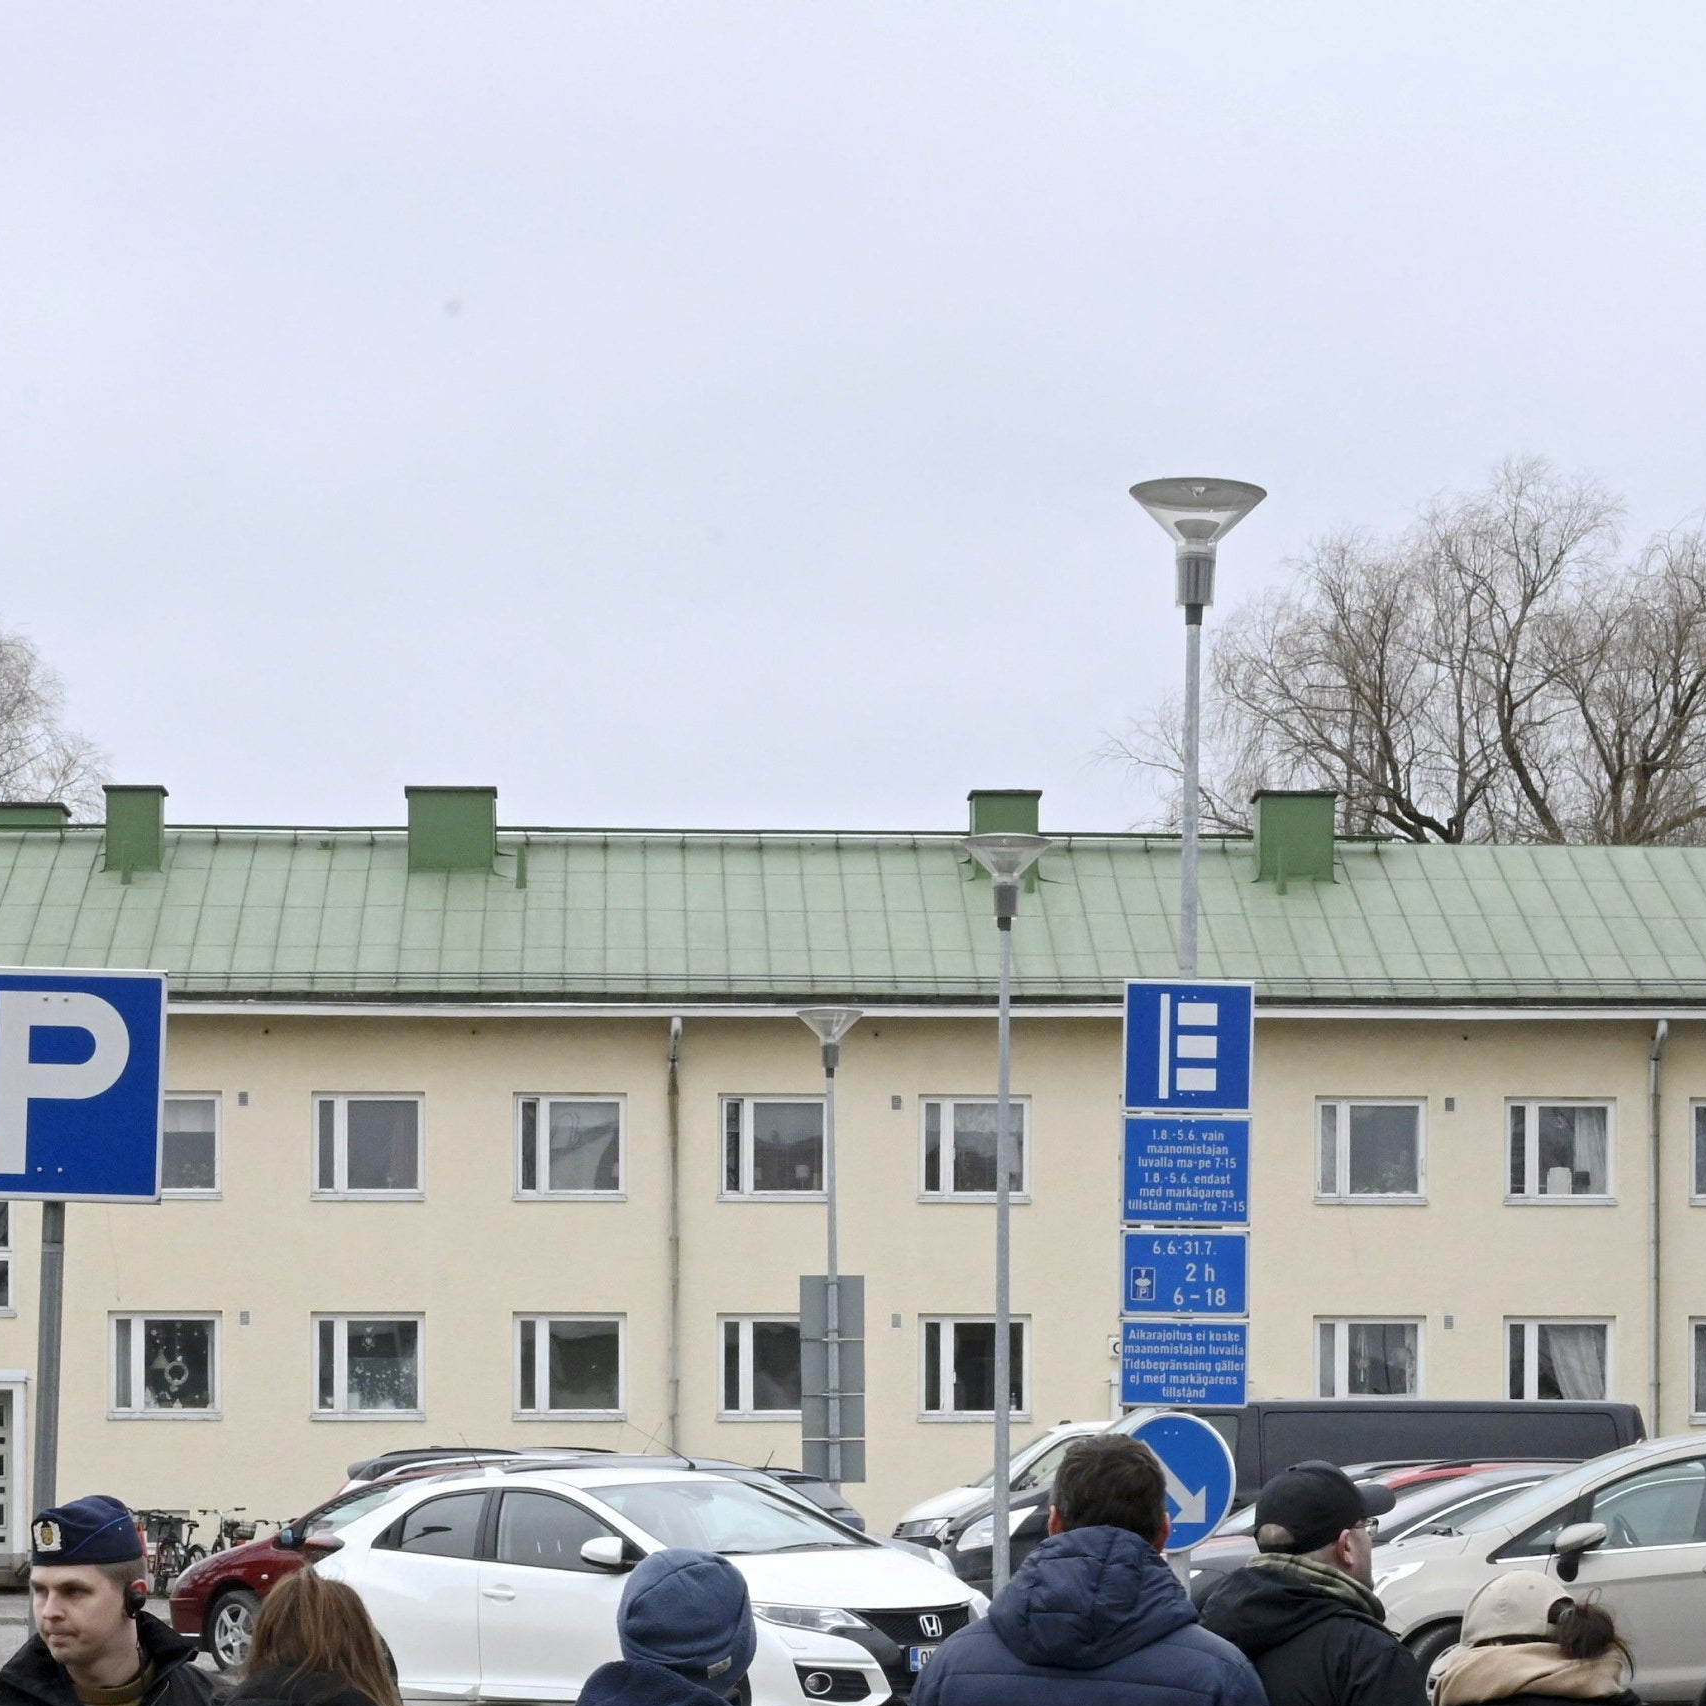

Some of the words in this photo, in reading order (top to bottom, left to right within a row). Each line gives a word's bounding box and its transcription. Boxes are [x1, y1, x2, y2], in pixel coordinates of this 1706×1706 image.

[1202, 1130, 1224, 1141] vain
[1147, 1144, 1229, 1156] maanomistajan
[1138, 1156, 1173, 1168] luvalla
[1177, 1160, 1211, 1170] ma-pe
[1215, 1157, 1237, 1169] 7-15
[1194, 1174, 1231, 1185] endast
[1139, 1186, 1162, 1197] med
[1166, 1187, 1234, 1199] markägarens
[1128, 1199, 1172, 1211] tillstånd
[1175, 1200, 1218, 1212] mån-fre
[1221, 1201, 1245, 1212] 7-15
[1185, 1263, 1197, 1282] 2
[1204, 1263, 1215, 1282] h
[1129, 1329, 1193, 1342] Aikarajoitus
[1196, 1331, 1206, 1341] ei
[1209, 1331, 1240, 1342] koske
[1124, 1343, 1206, 1356] maanomistajan
[1209, 1344, 1245, 1356] luvalla
[1124, 1358, 1212, 1372] Tidsbegränsning
[1215, 1360, 1245, 1372] gäller
[1130, 1374, 1140, 1385] ej
[1143, 1373, 1166, 1384] med
[1169, 1373, 1238, 1386] markägarens
[1162, 1387, 1206, 1398] tillstånd
